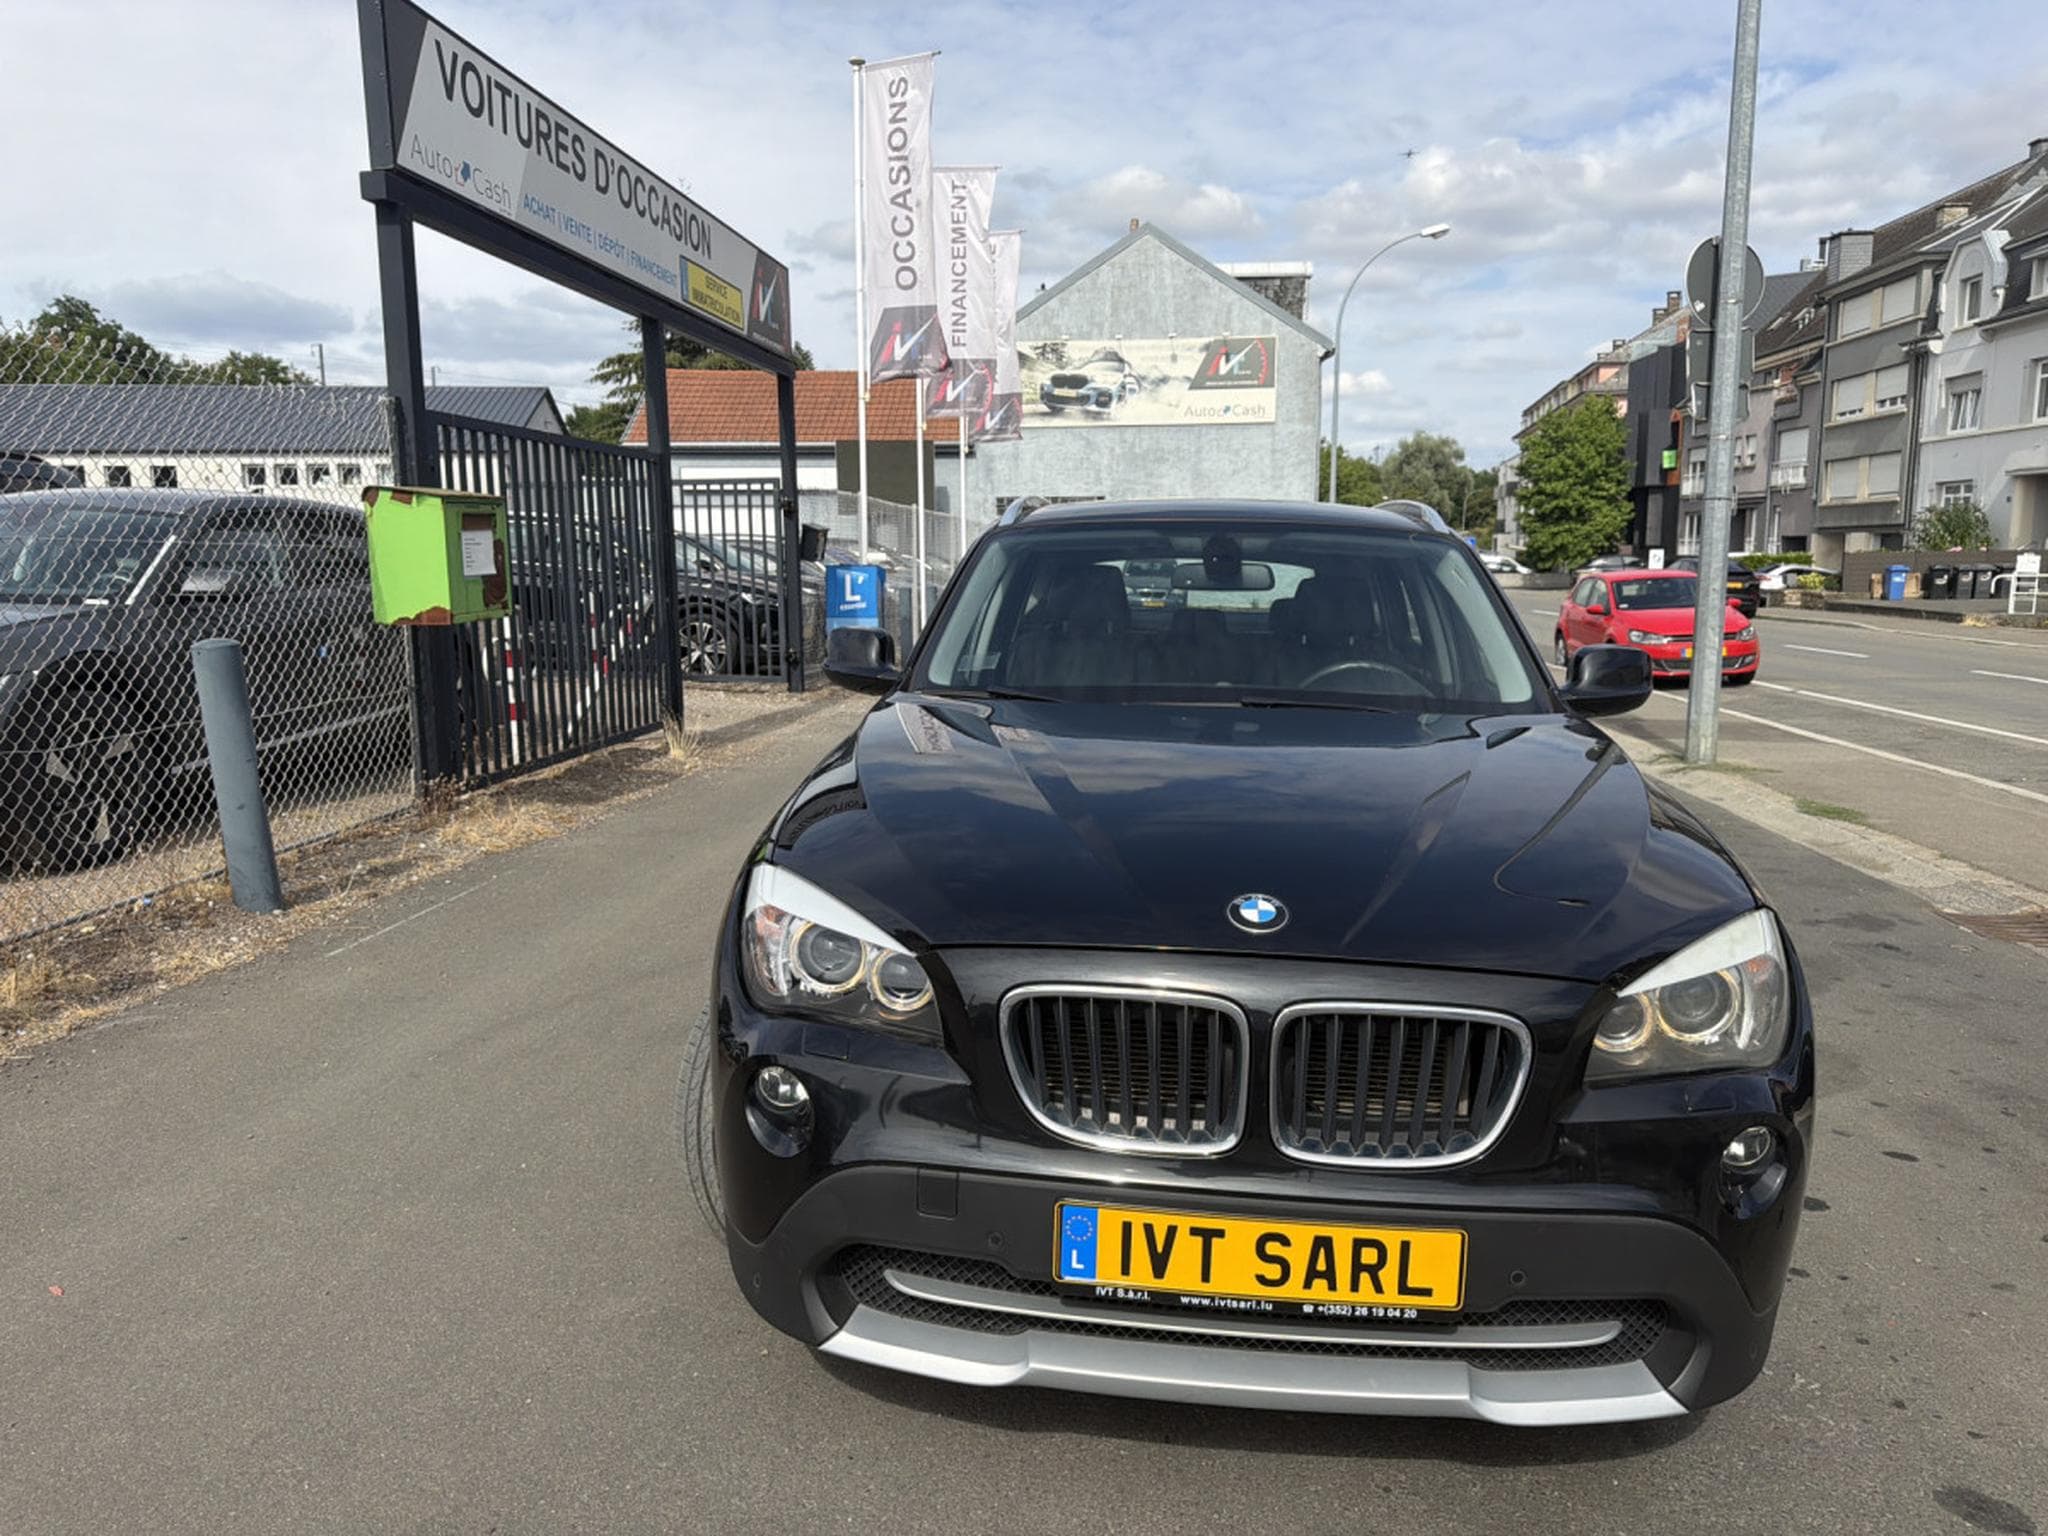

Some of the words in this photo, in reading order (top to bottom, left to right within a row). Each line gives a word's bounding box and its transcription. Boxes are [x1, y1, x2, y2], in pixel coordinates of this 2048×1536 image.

[411, 133, 453, 178] Auto
[473, 167, 512, 209] Cash
[434, 38, 587, 182] VOITURES
[595, 148, 712, 260] D'OCCASION
[887, 76, 918, 291] OCCASIONS
[523, 193, 557, 225] ACHAT
[562, 214, 593, 244] VENTE
[951, 179, 968, 348] FINANCEMENT
[1183, 405, 1217, 418] Auto
[1231, 403, 1267, 418] Cash
[1071, 1249, 1085, 1270] L
[1120, 1220, 1227, 1284] IVT
[1254, 1231, 1434, 1298] SARL
[1095, 1286, 1115, 1297] IVT
[1179, 1295, 1274, 1311] www.ivtsarl.lu
[1371, 1307, 1386, 1318] 19
[1386, 1307, 1402, 1318] 04
[1403, 1308, 1418, 1319] 20
